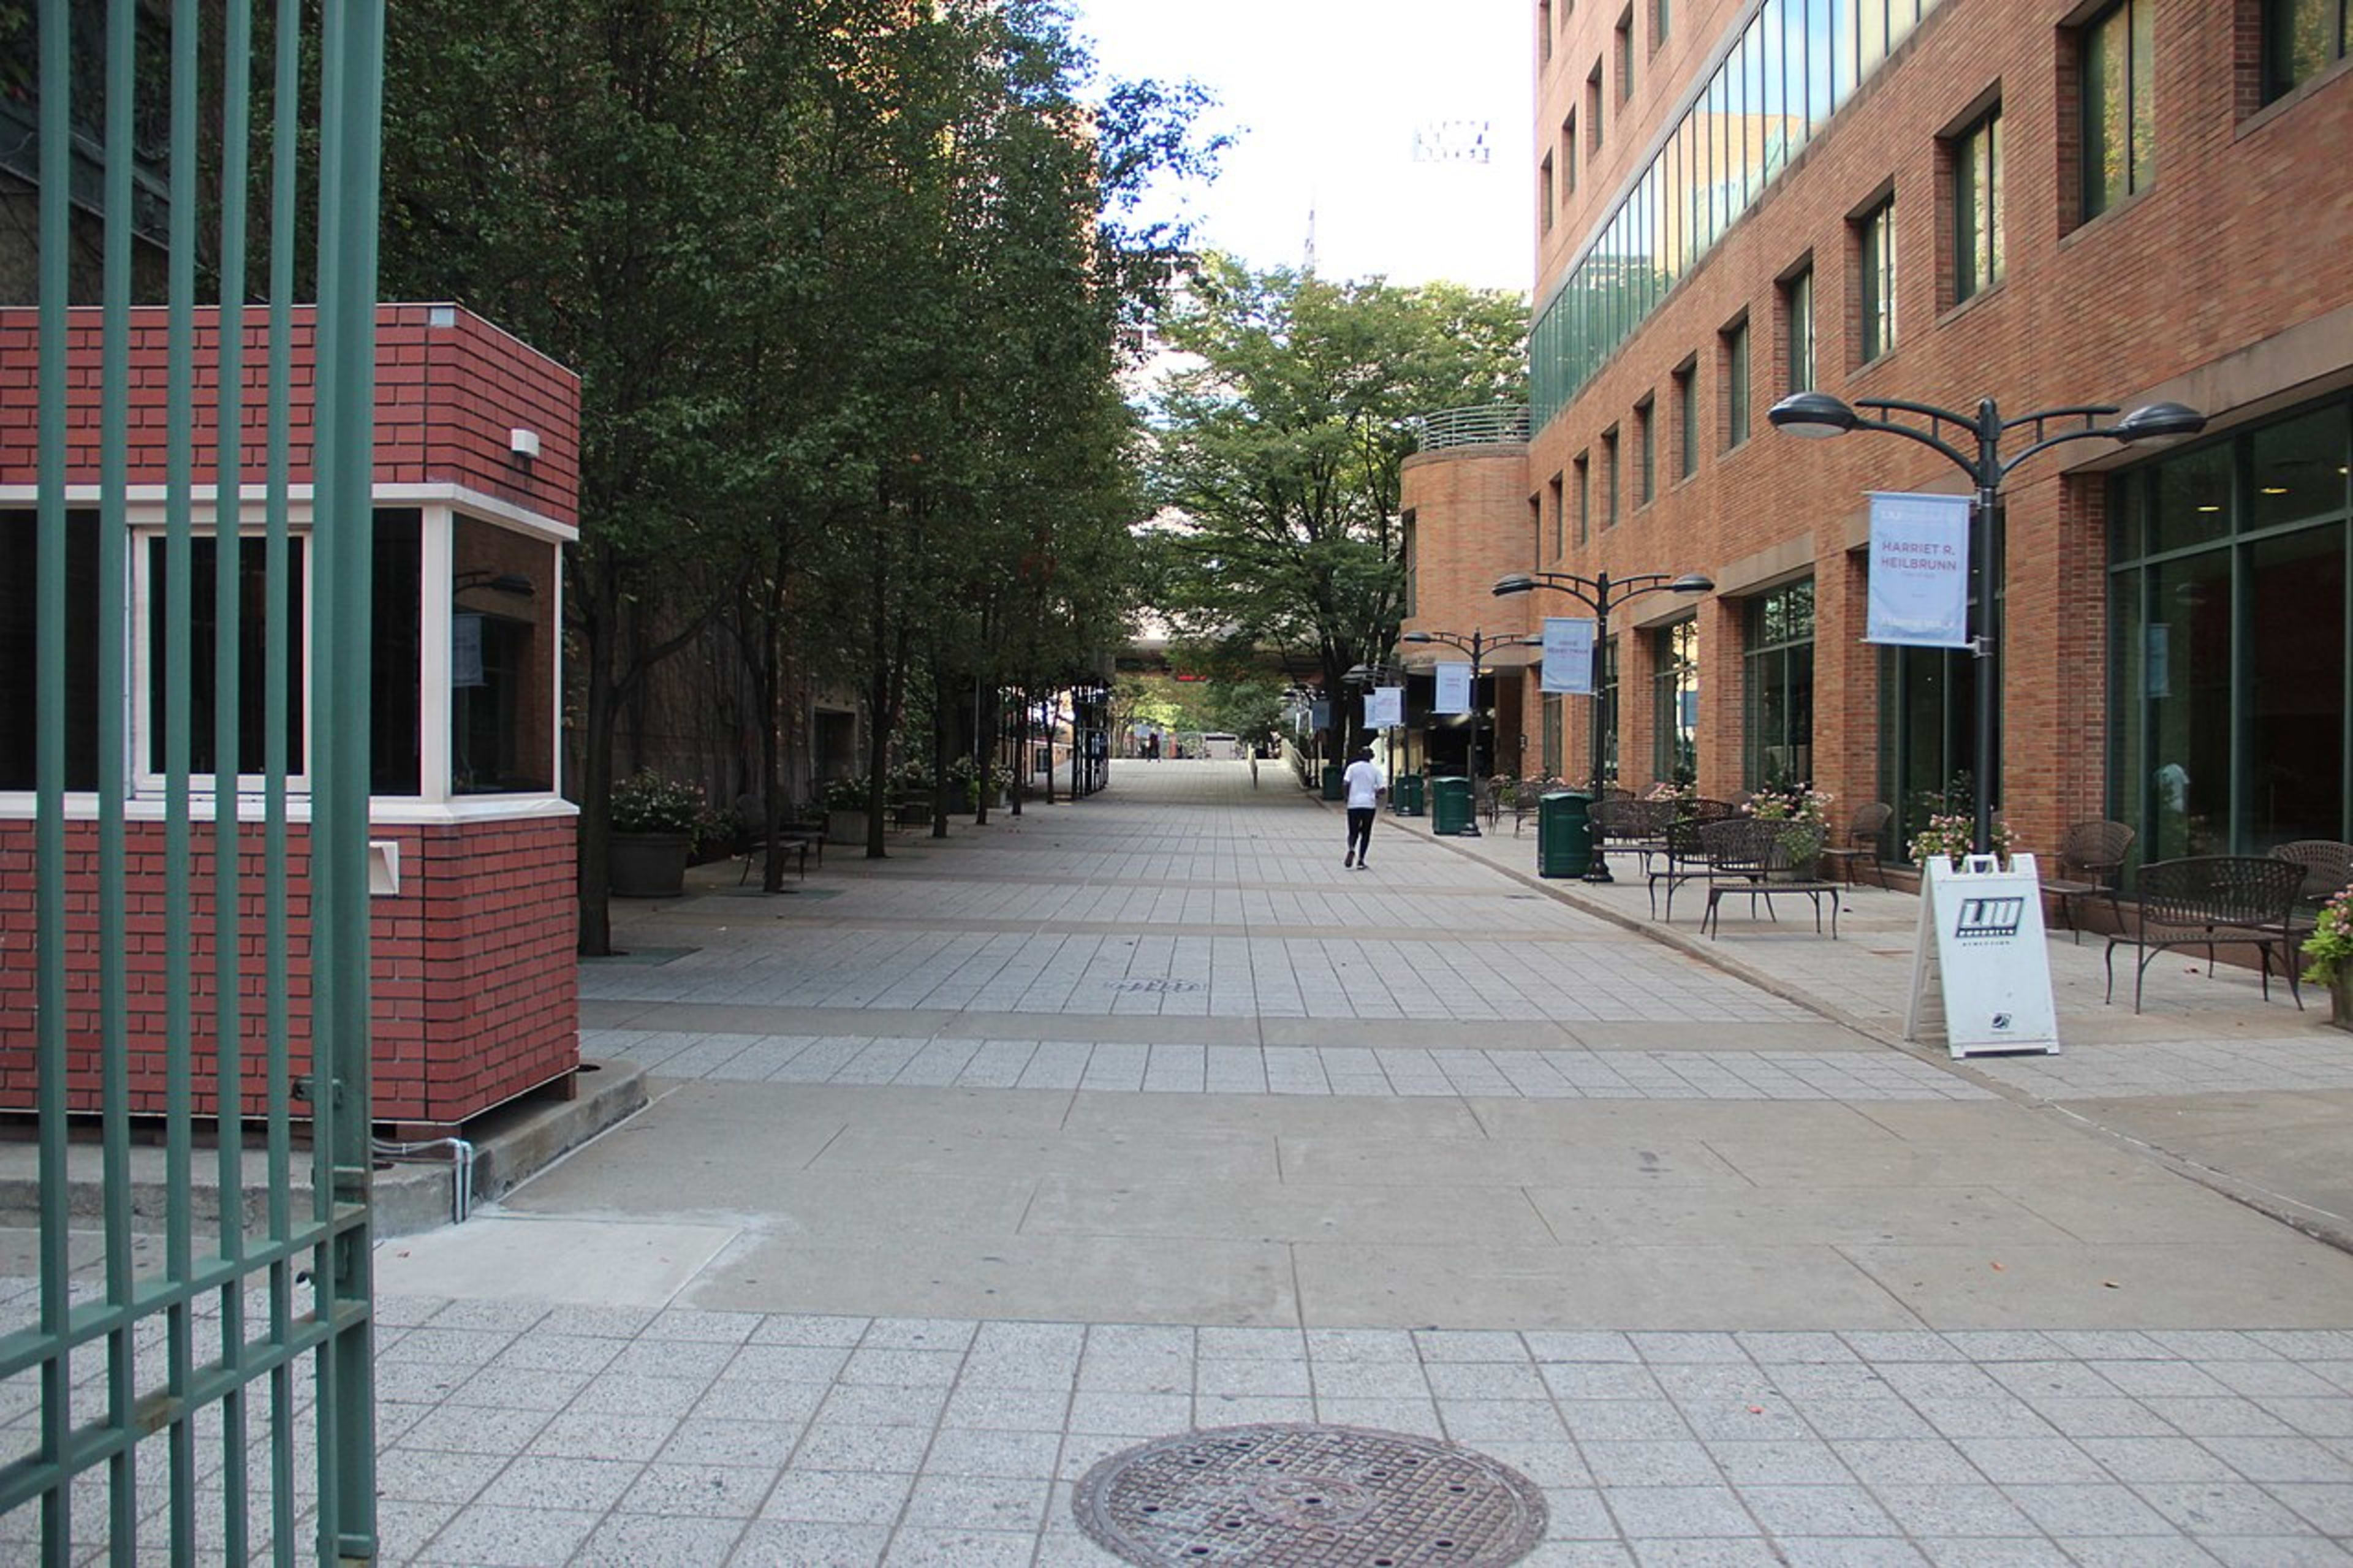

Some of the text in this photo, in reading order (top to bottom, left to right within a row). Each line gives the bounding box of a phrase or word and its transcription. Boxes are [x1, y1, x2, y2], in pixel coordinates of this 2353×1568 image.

[1882, 541, 1955, 556] HARRIET R.
[1881, 557, 1957, 570] HEILBRUNN
[1960, 900, 2021, 928] LIU
